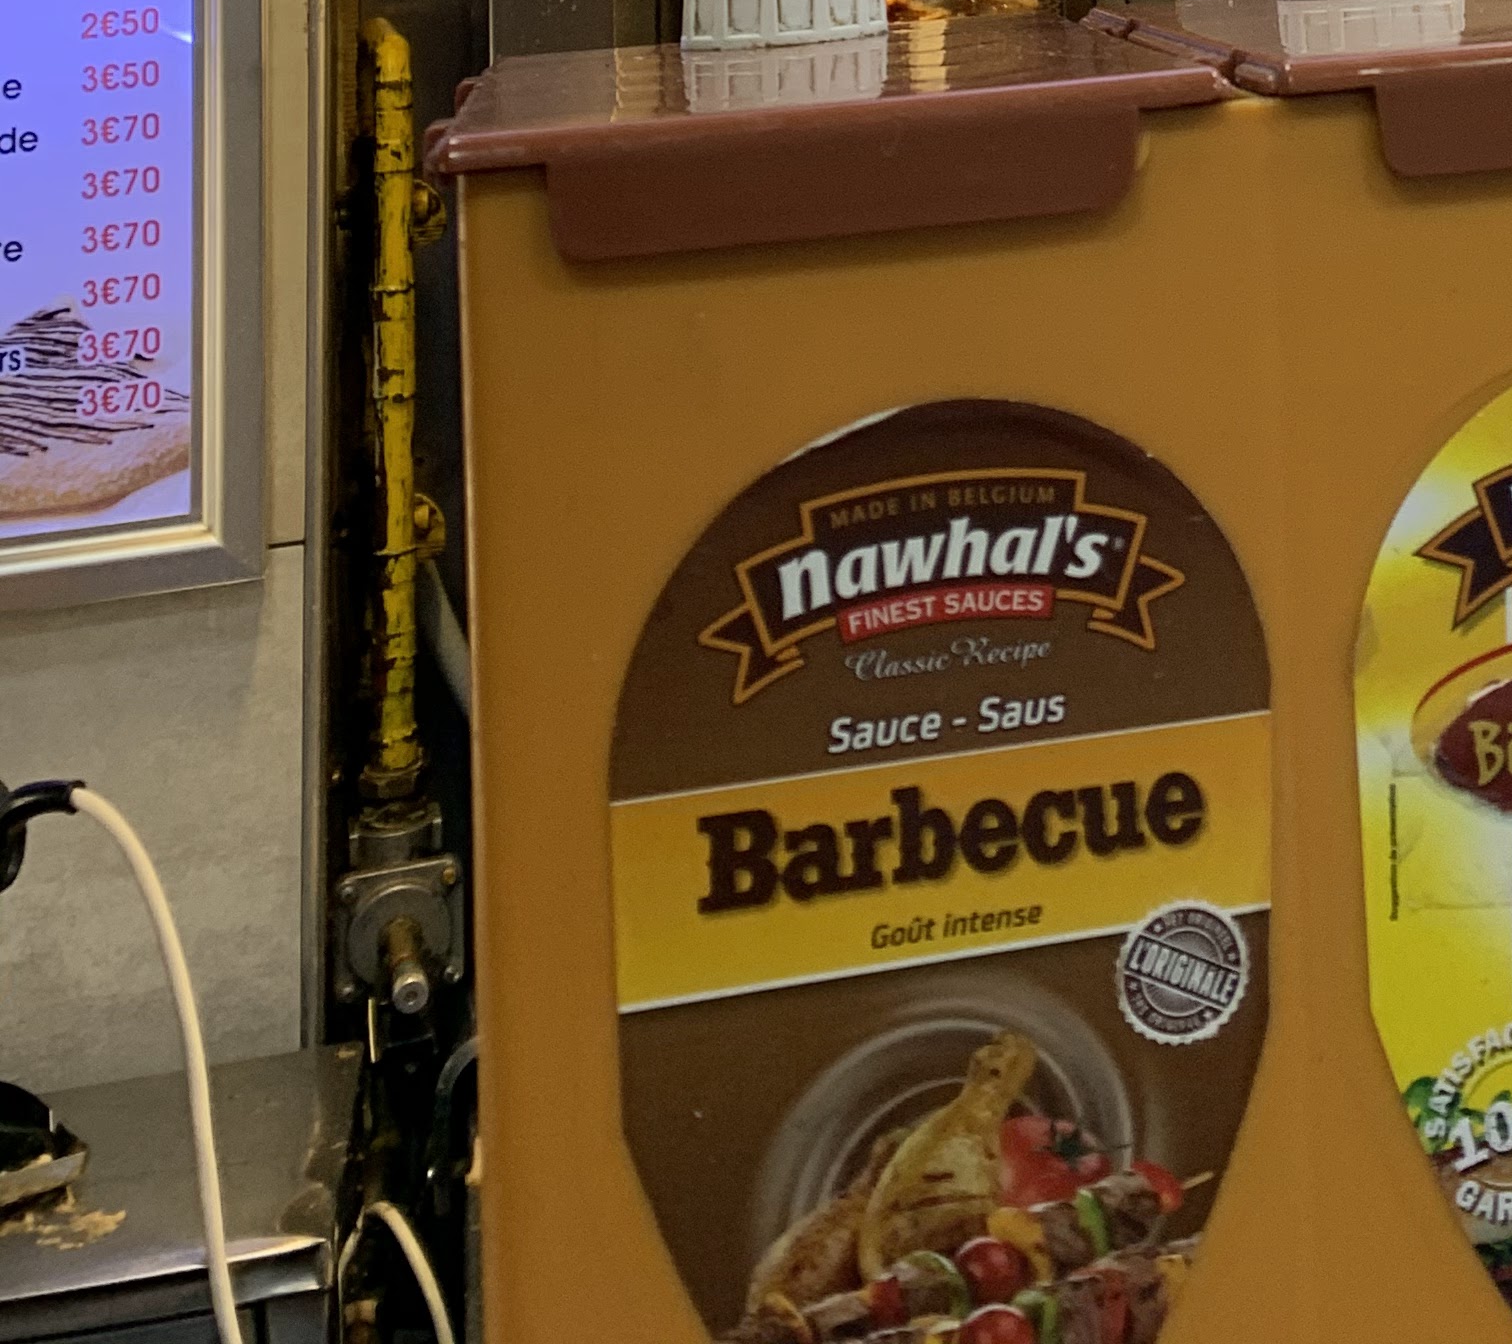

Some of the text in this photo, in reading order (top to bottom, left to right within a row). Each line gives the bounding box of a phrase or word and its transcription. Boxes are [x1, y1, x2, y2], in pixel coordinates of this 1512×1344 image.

[81, 7, 159, 40] 2€50
[81, 60, 160, 93] 3€50
[81, 113, 160, 146] 3€70
[81, 166, 160, 200] 3€70
[81, 220, 160, 255] 3€70
[81, 273, 160, 308] 3€70
[81, 327, 160, 363] 3€70
[81, 381, 161, 415] 3€70
[831, 486, 1056, 529] MADE IN BELGIUM
[778, 514, 1108, 620] nawhal's
[848, 590, 1044, 635] FINEST SAUCES
[845, 637, 1051, 681] Classic Recipe
[827, 694, 1066, 754] Sauce Saus
[697, 771, 1206, 915] Barbecue
[871, 904, 1042, 951] Goût intense
